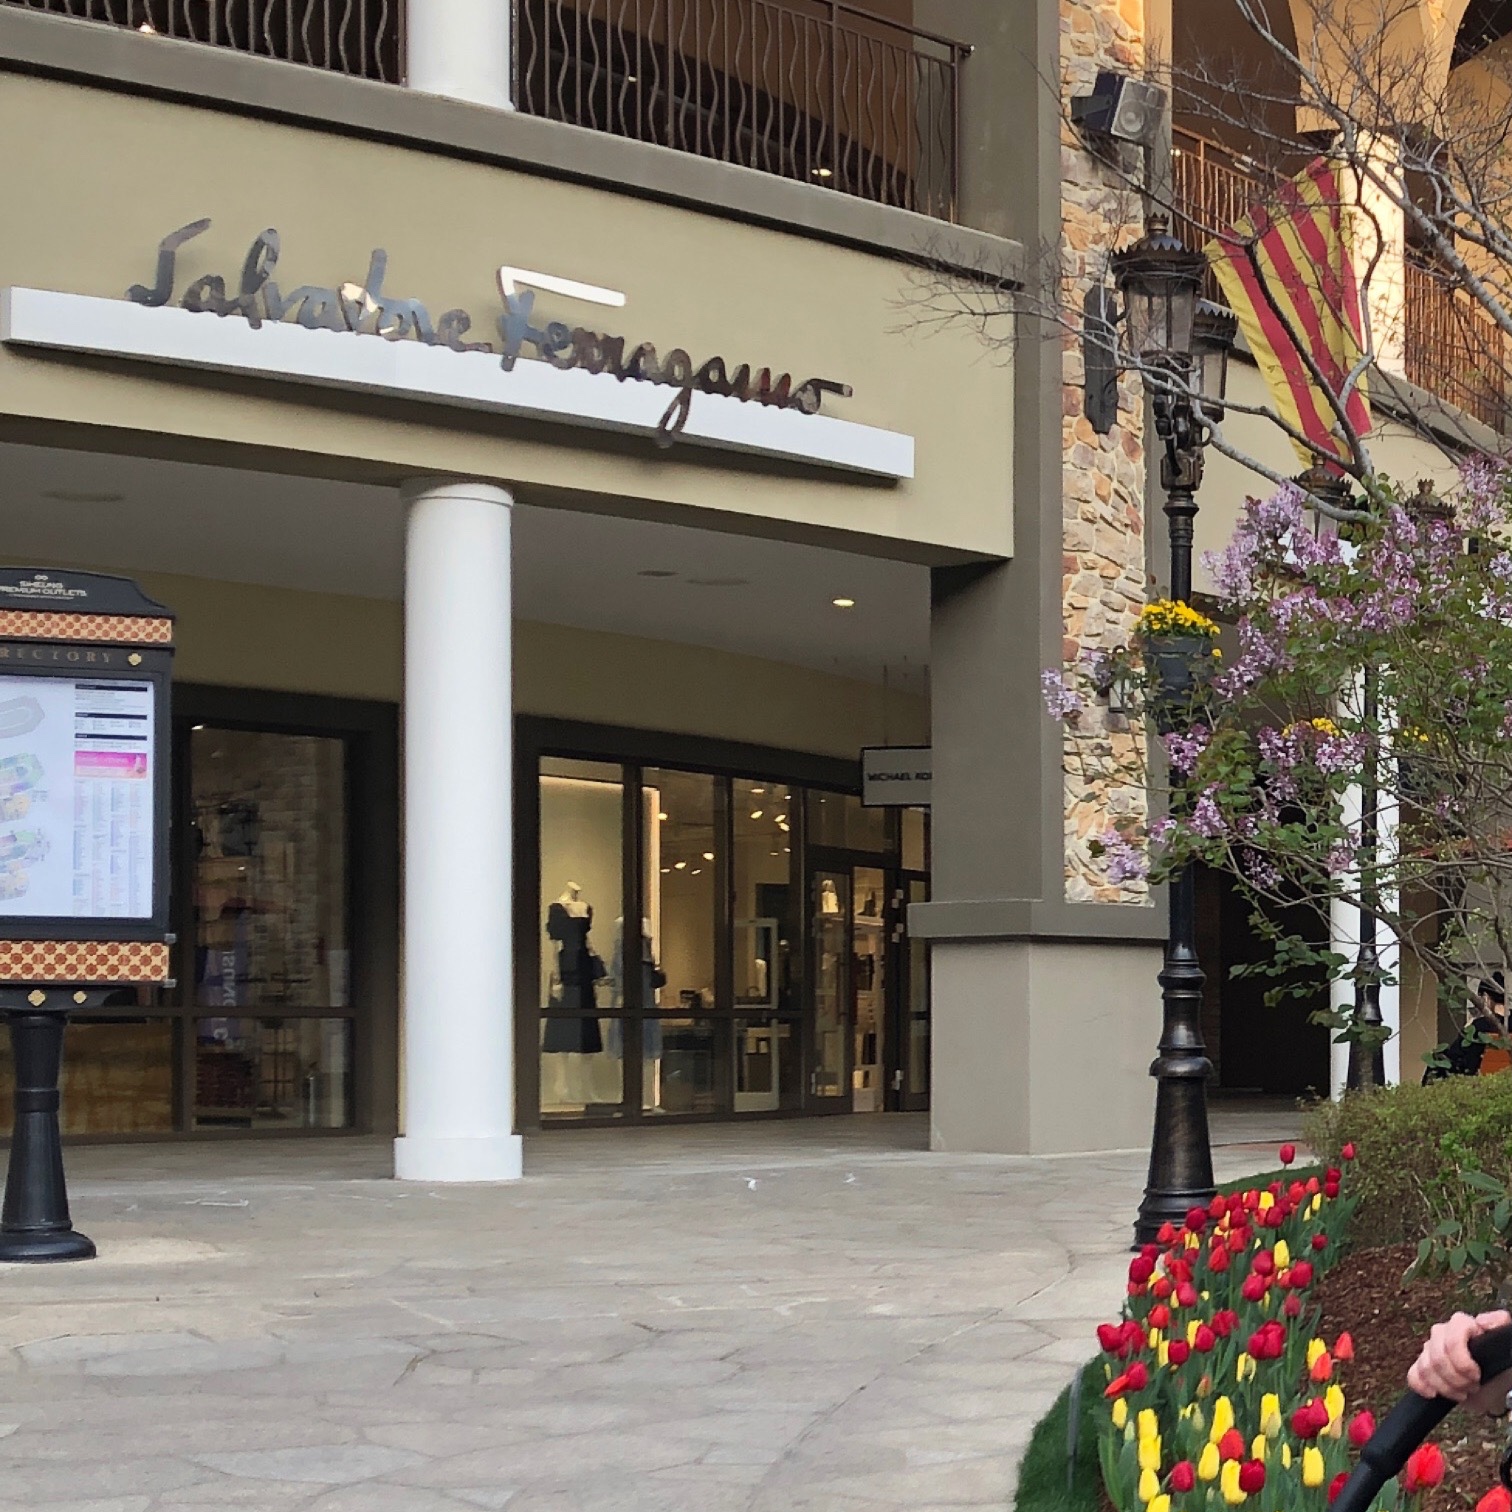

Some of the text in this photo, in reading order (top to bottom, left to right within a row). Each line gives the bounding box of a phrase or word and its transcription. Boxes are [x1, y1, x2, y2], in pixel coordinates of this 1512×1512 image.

[127, 217, 854, 449] Salvatore Ferragamo
[868, 772, 911, 781] MICHAEL
